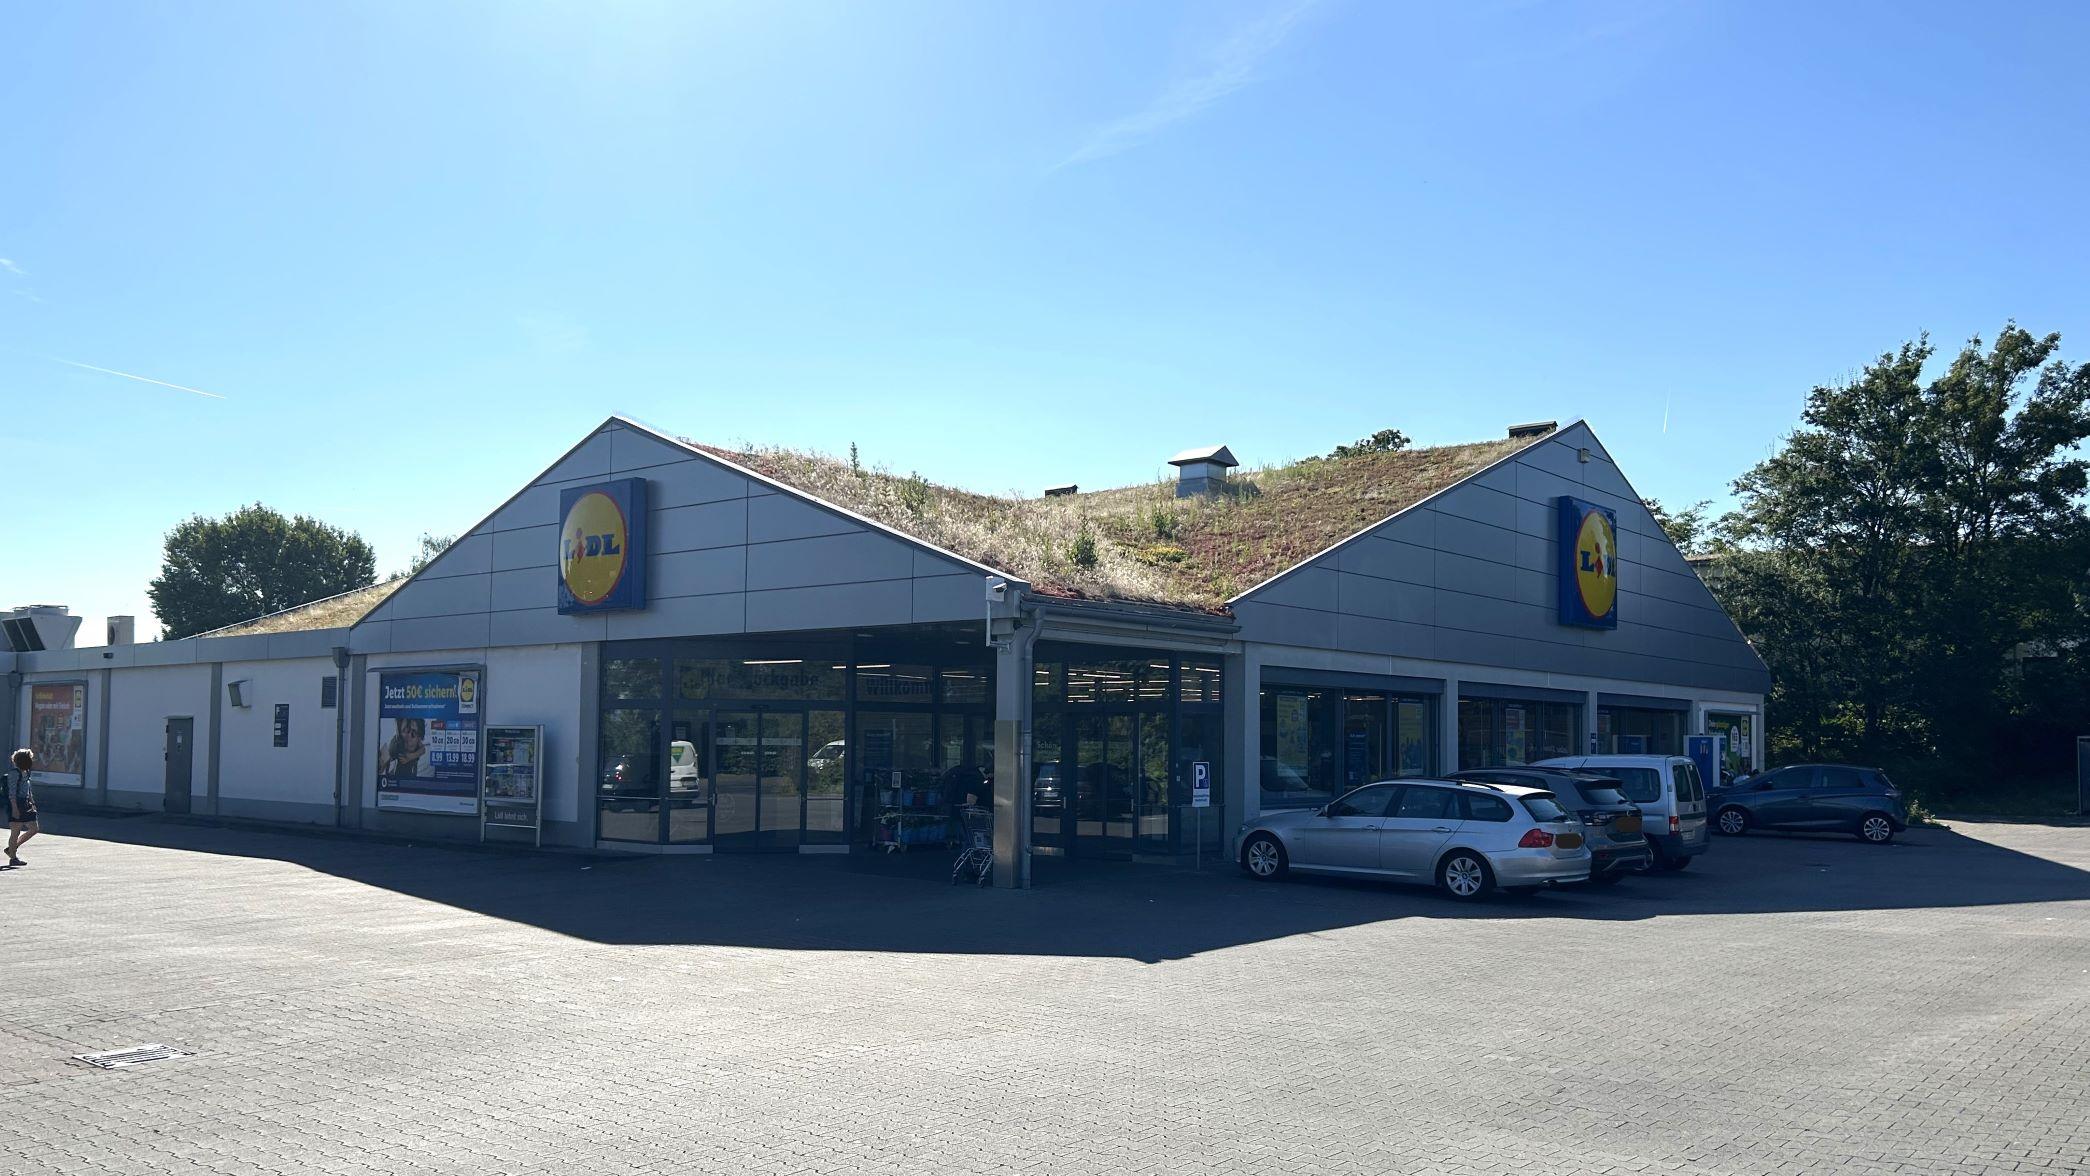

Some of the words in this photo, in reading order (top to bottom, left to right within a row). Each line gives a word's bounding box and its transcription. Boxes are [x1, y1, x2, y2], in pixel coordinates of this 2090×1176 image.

[385, 685, 405, 699] Jetzt
[406, 684, 423, 698] 50€
[1195, 764, 1205, 787] P
